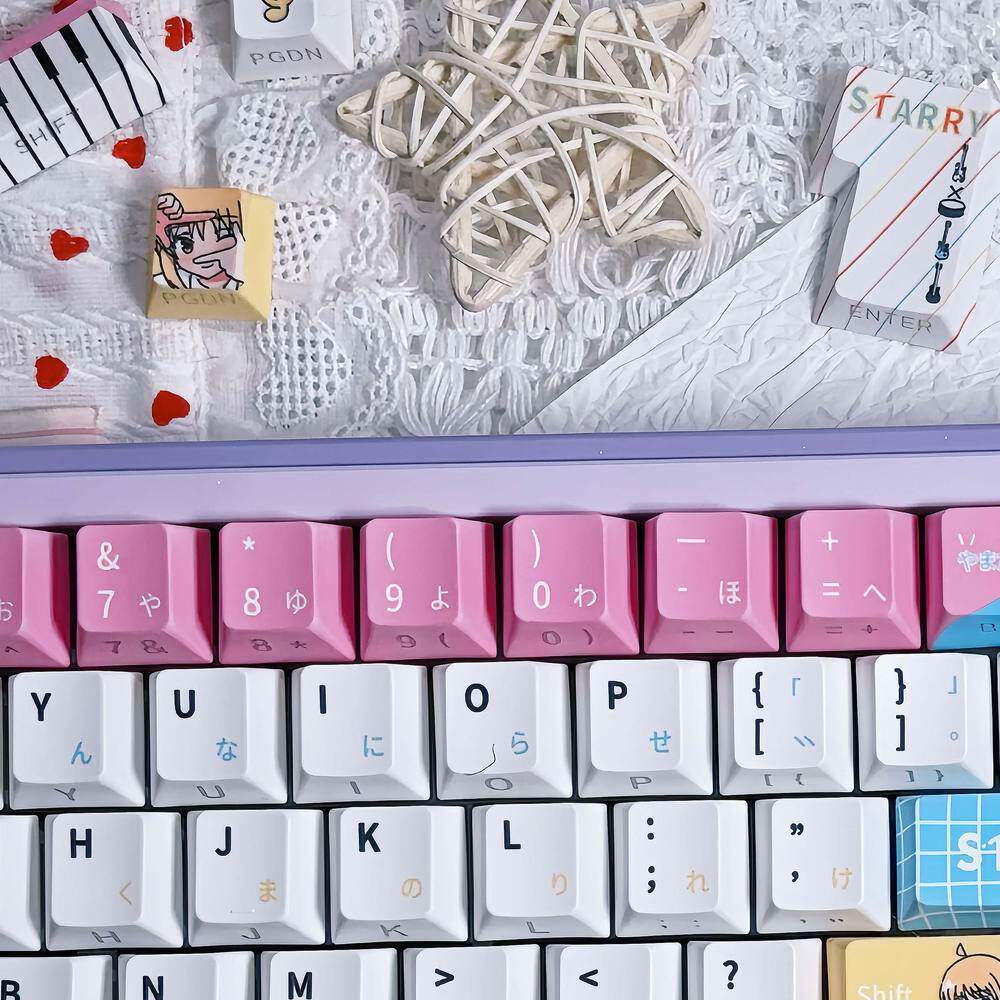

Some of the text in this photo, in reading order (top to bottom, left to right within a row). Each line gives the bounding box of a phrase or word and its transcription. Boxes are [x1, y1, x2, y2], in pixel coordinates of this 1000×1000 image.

[250, 48, 323, 64] PGDN
[848, 86, 988, 137] STARRY
[16, 108, 80, 154] SHIFT
[850, 304, 932, 333] ENTER
[97, 542, 120, 571] &
[97, 590, 114, 618] 7
[244, 588, 262, 616] 8
[386, 584, 403, 612] 9
[31, 693, 51, 721] Y
[174, 690, 195, 718] U
[608, 681, 627, 709] P
[71, 742, 92, 764] ん
[216, 738, 237, 761] な
[364, 735, 384, 757] に
[512, 732, 528, 754] ら
[650, 730, 671, 753] せ
[70, 829, 92, 858] H
[215, 826, 231, 856] J
[358, 823, 380, 852] K
[504, 820, 521, 849] L
[832, 868, 853, 890] け
[288, 972, 312, 1000] M
[723, 960, 738, 989] ?
